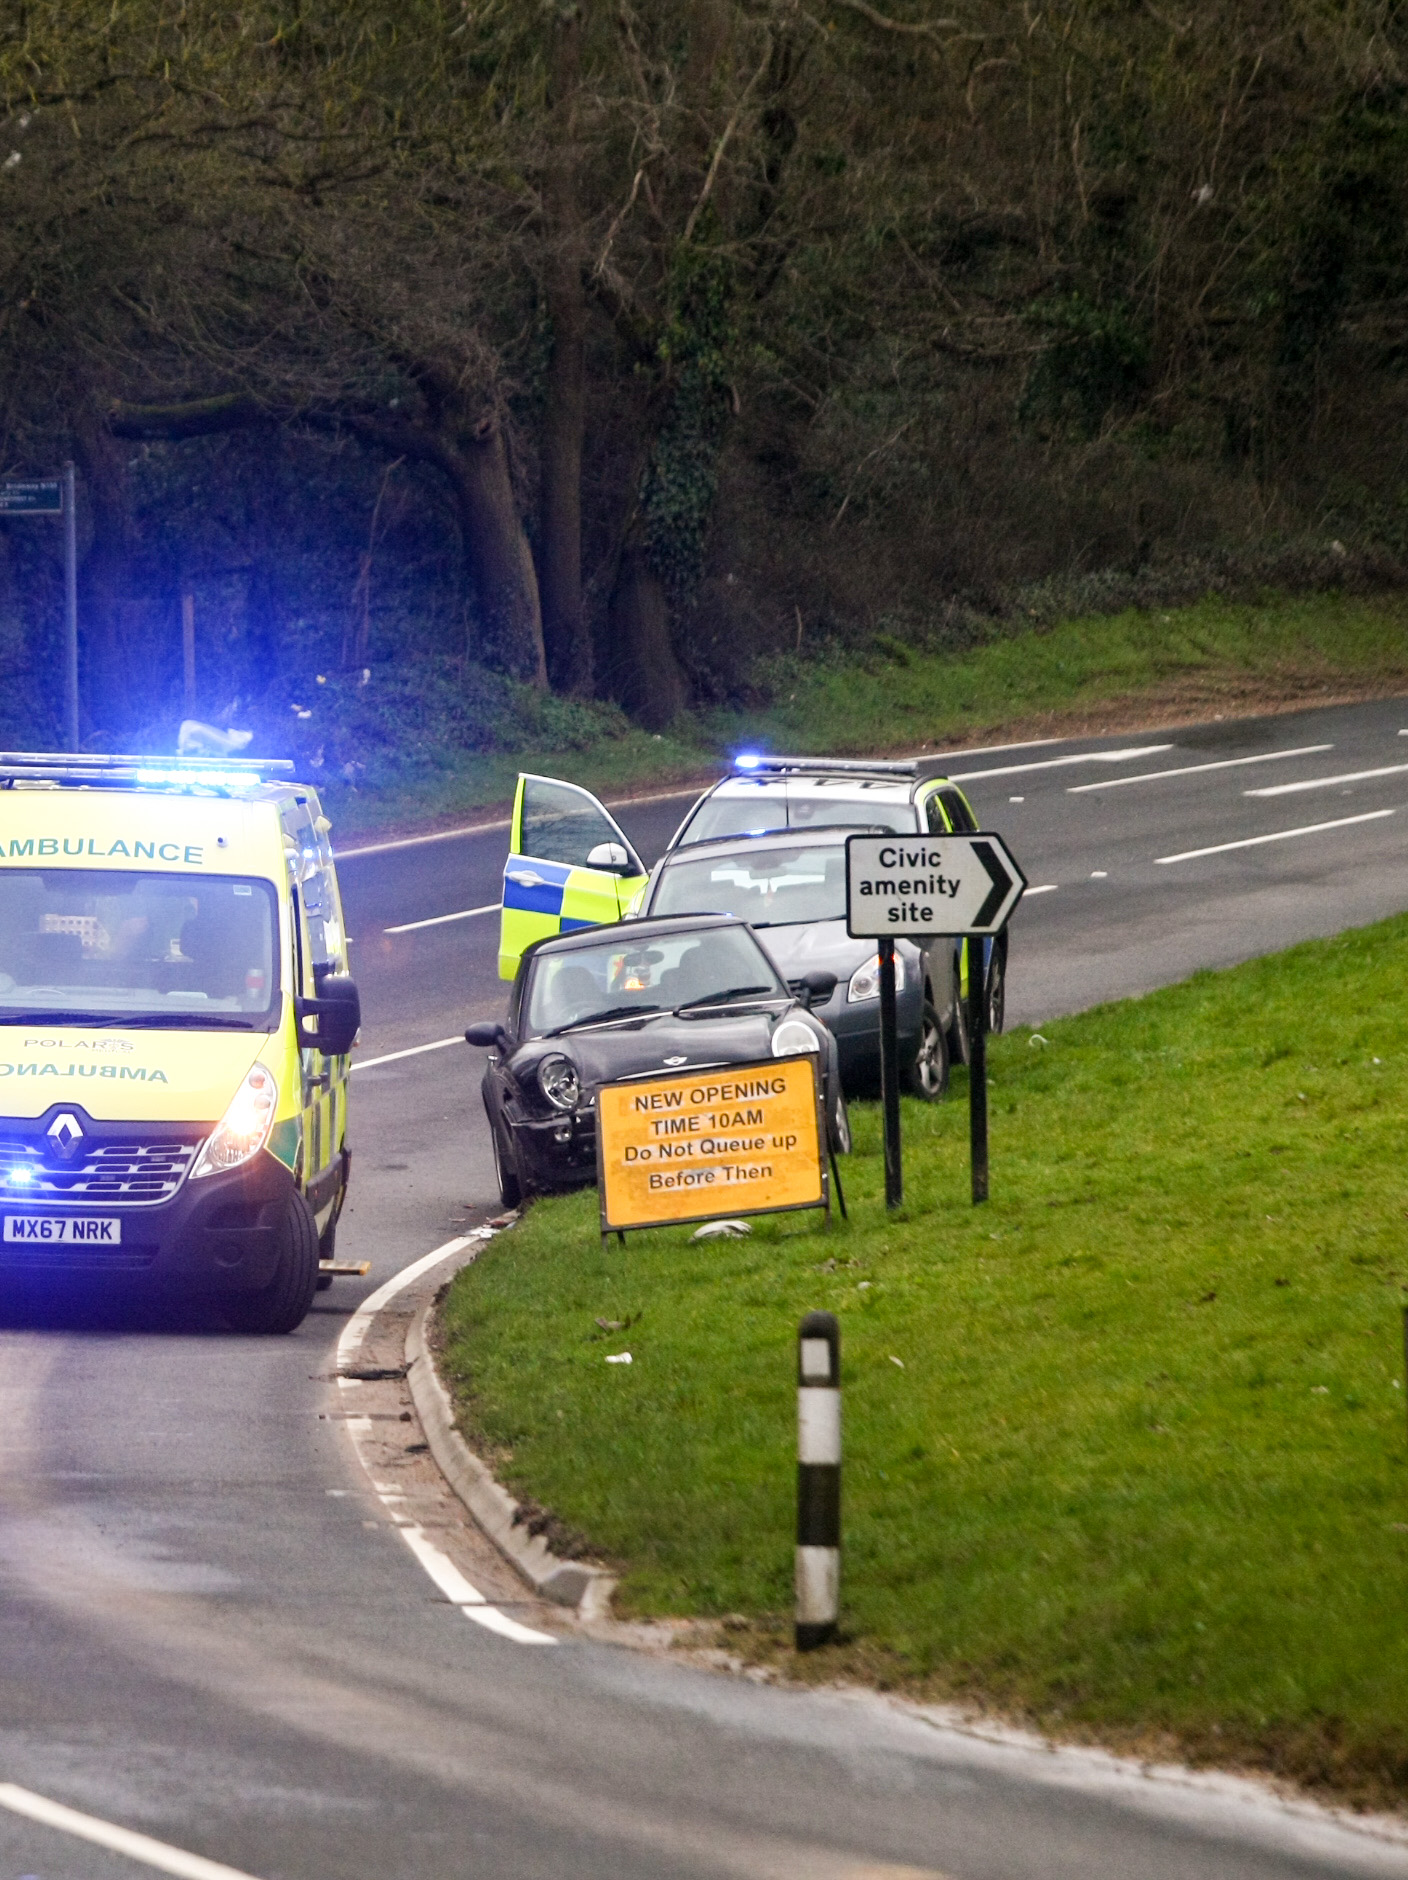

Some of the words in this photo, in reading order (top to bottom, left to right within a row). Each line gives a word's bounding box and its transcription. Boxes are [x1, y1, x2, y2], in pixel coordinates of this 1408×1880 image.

[879, 847, 942, 868] Civic
[859, 875, 961, 898] amenity
[887, 902, 934, 922] site
[634, 1090, 684, 1112] NEW
[689, 1077, 787, 1105] OPENING
[650, 1115, 701, 1136] TIME
[707, 1109, 764, 1130] 10AM
[625, 1145, 652, 1162] Do
[659, 1141, 694, 1159] Not
[700, 1137, 765, 1156] Queue
[772, 1134, 798, 1151] up
[649, 1168, 716, 1190] Before
[723, 1164, 773, 1182] Then
[12, 1219, 67, 1239] MX67
[72, 1220, 113, 1240] NRK
